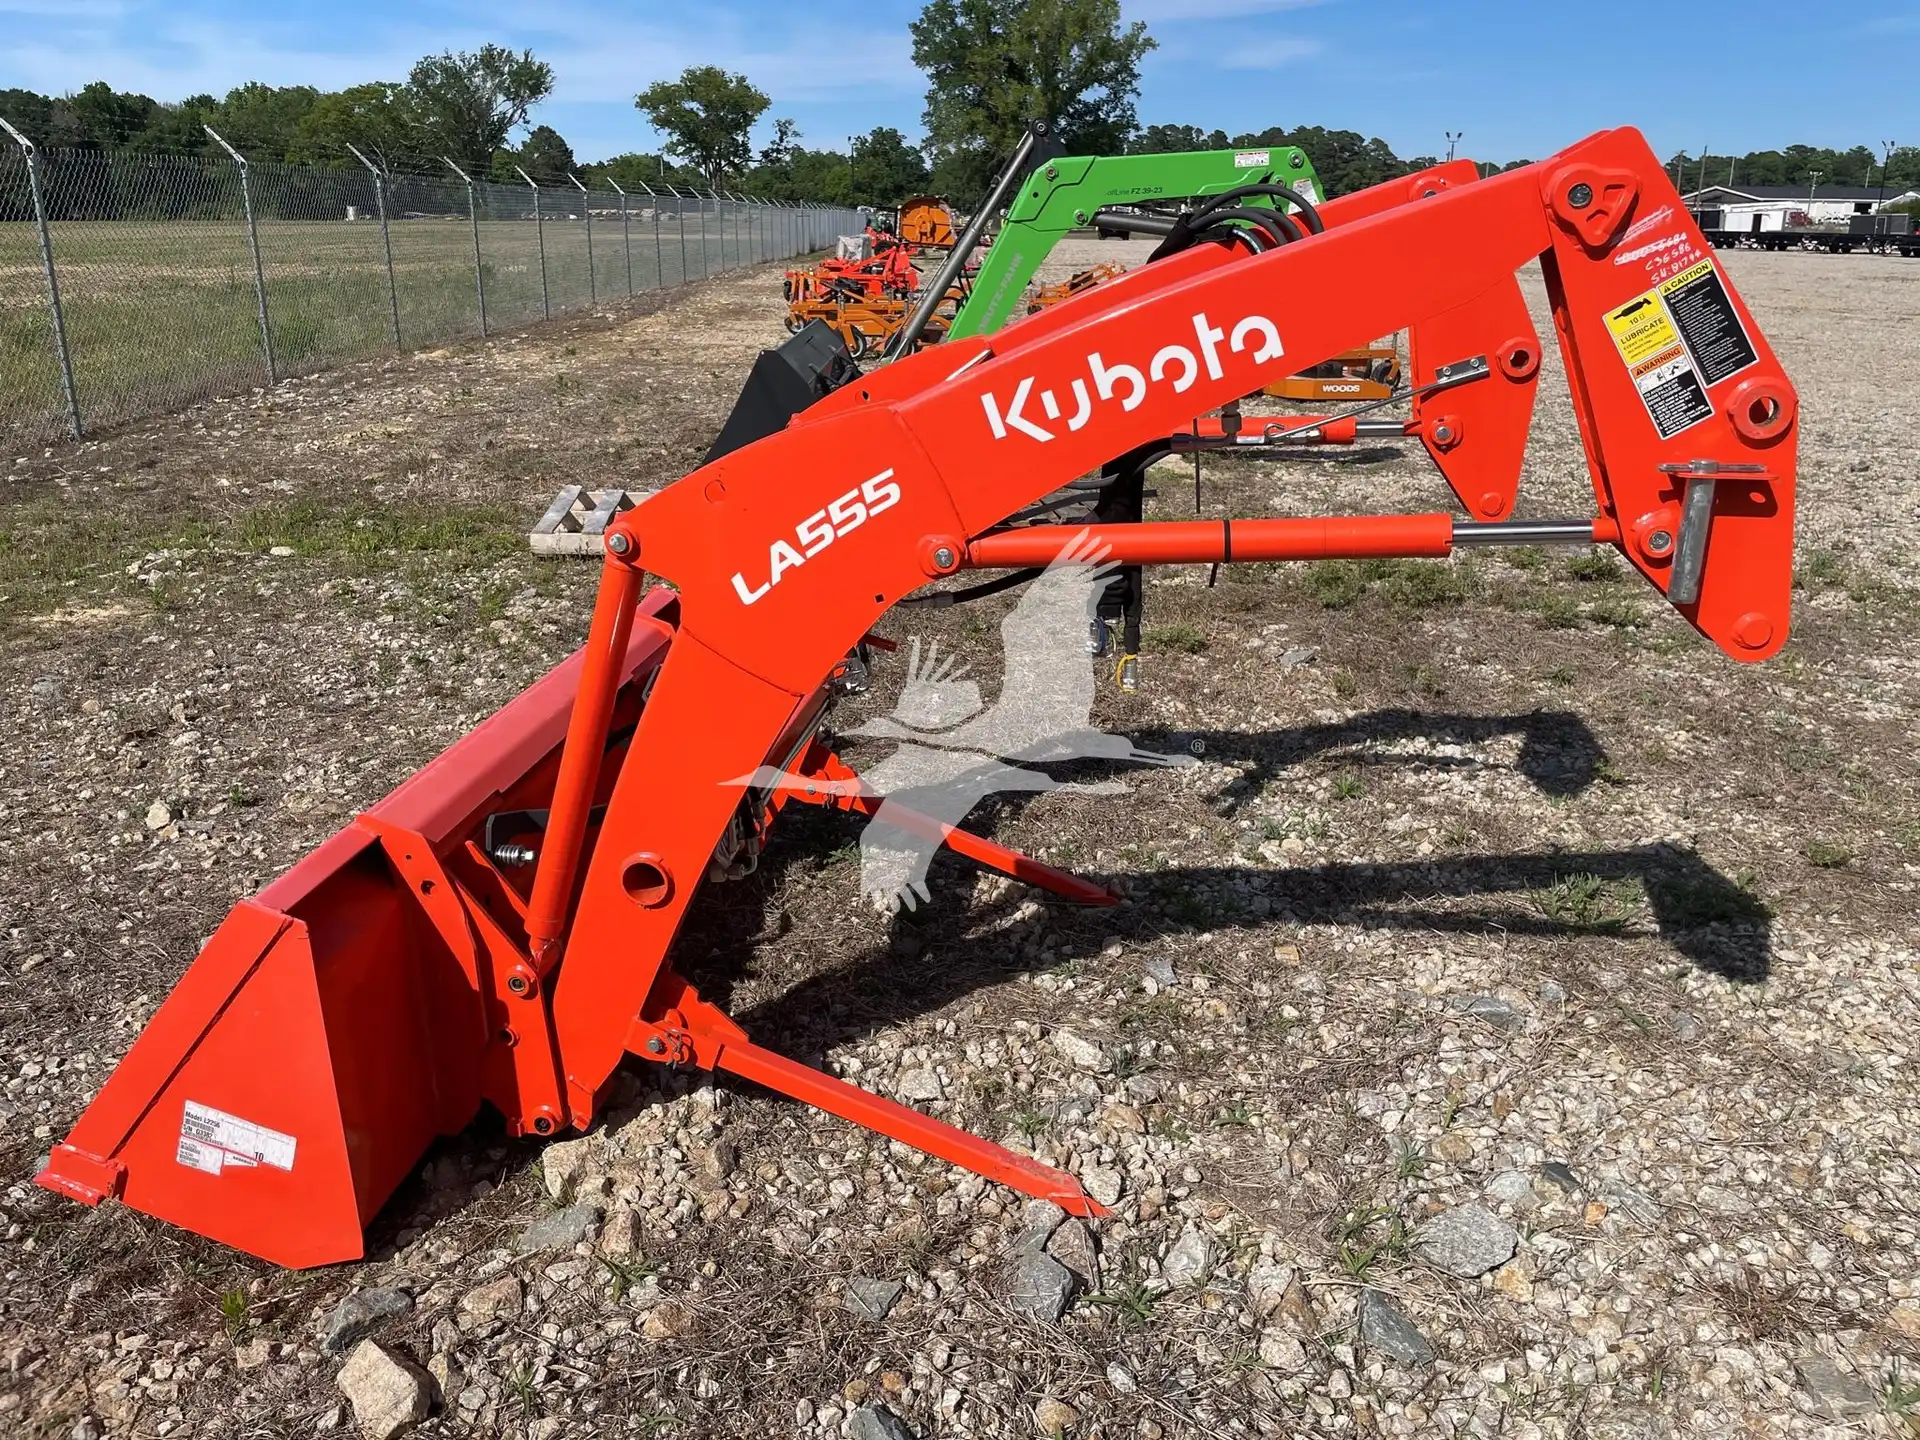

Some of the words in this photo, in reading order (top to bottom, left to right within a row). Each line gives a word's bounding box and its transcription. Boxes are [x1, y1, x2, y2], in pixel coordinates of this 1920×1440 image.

[1142, 186, 1163, 194] 39-23
[1670, 263, 1709, 288] CAUTION
[1628, 317, 1639, 326] 10
[1620, 317, 1665, 345] LUBRICATE
[1641, 347, 1681, 372] WARNING
[980, 313, 1285, 443] Kubota
[1322, 384, 1360, 392] WOODS
[731, 468, 901, 606] LA555
[185, 1111, 202, 1121] Model
[254, 1151, 264, 1161] 10
